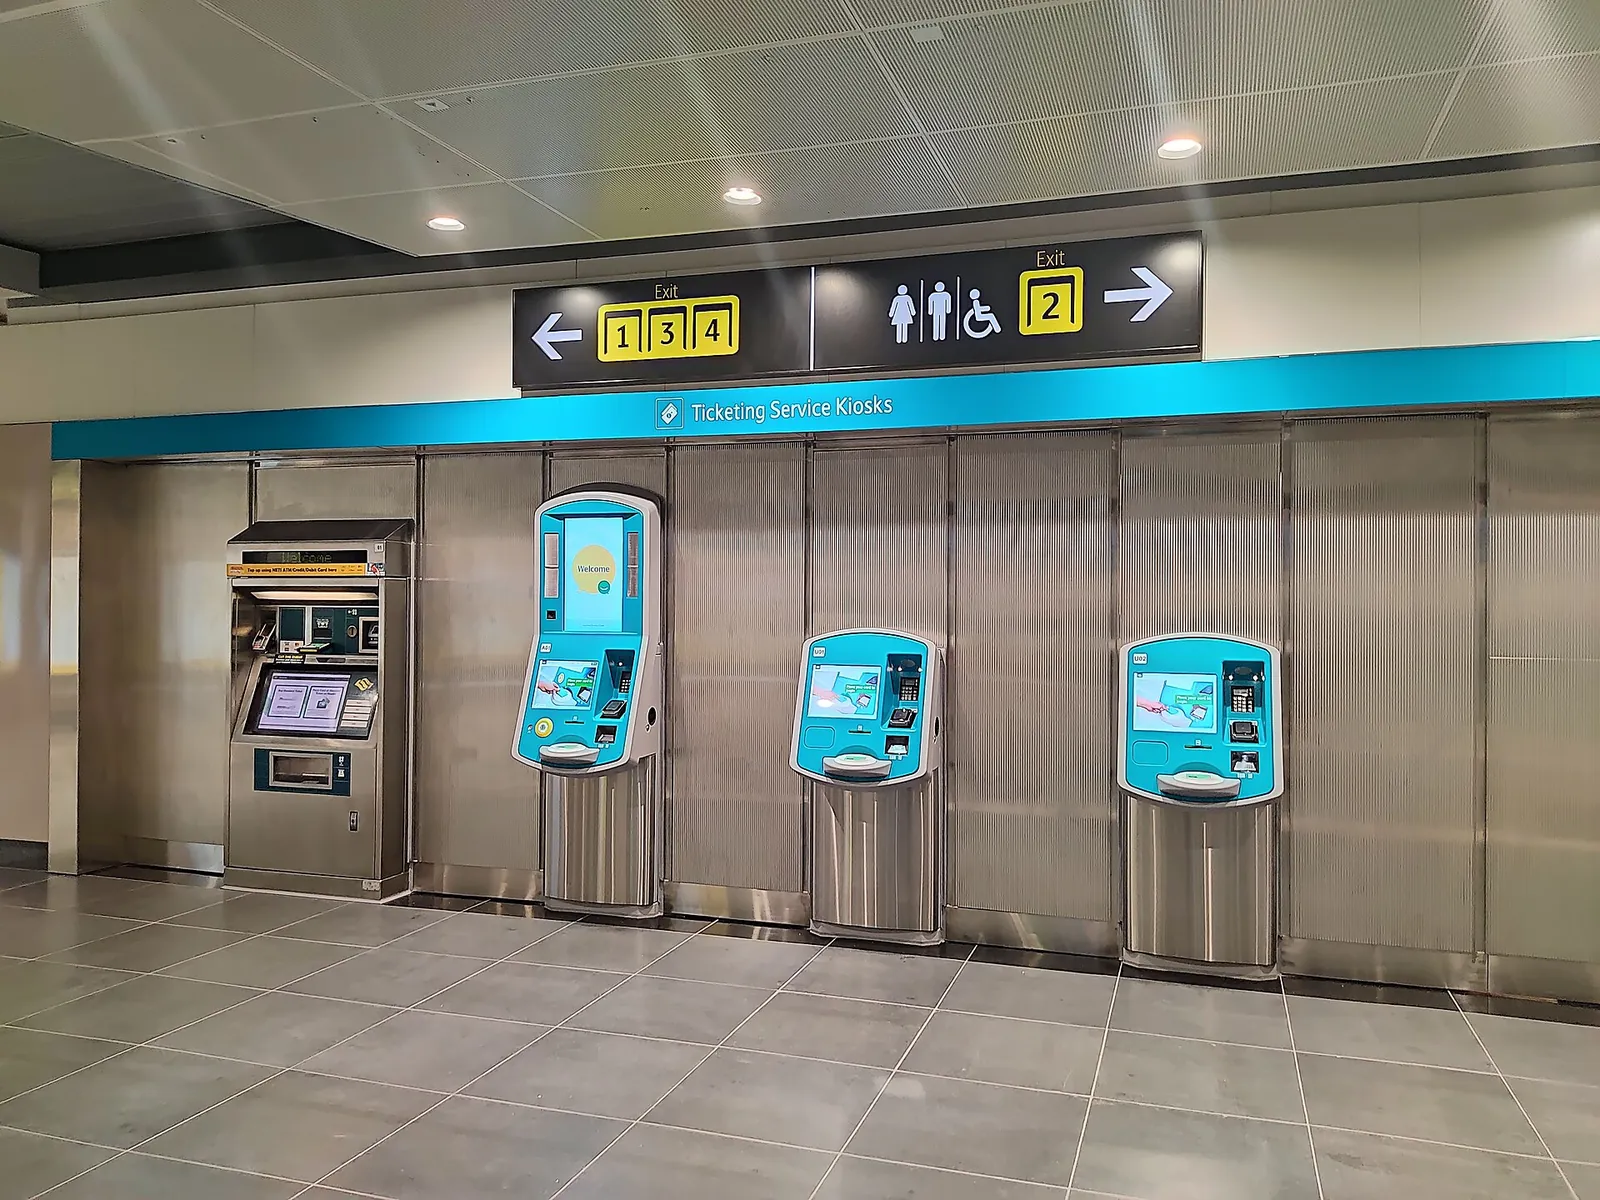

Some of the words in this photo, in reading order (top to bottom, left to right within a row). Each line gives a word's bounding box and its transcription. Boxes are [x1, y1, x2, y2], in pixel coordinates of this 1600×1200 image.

[1036, 249, 1066, 268] Exit
[654, 284, 679, 300] Exit
[1041, 292, 1060, 320] 2
[616, 324, 630, 349] 1
[659, 320, 675, 346] 3
[704, 318, 721, 343] 4
[691, 402, 766, 424] Ticketing
[769, 399, 832, 419] Service
[835, 395, 894, 416] Kiosks
[281, 552, 332, 563] Welcome
[577, 565, 610, 573] Welcome
